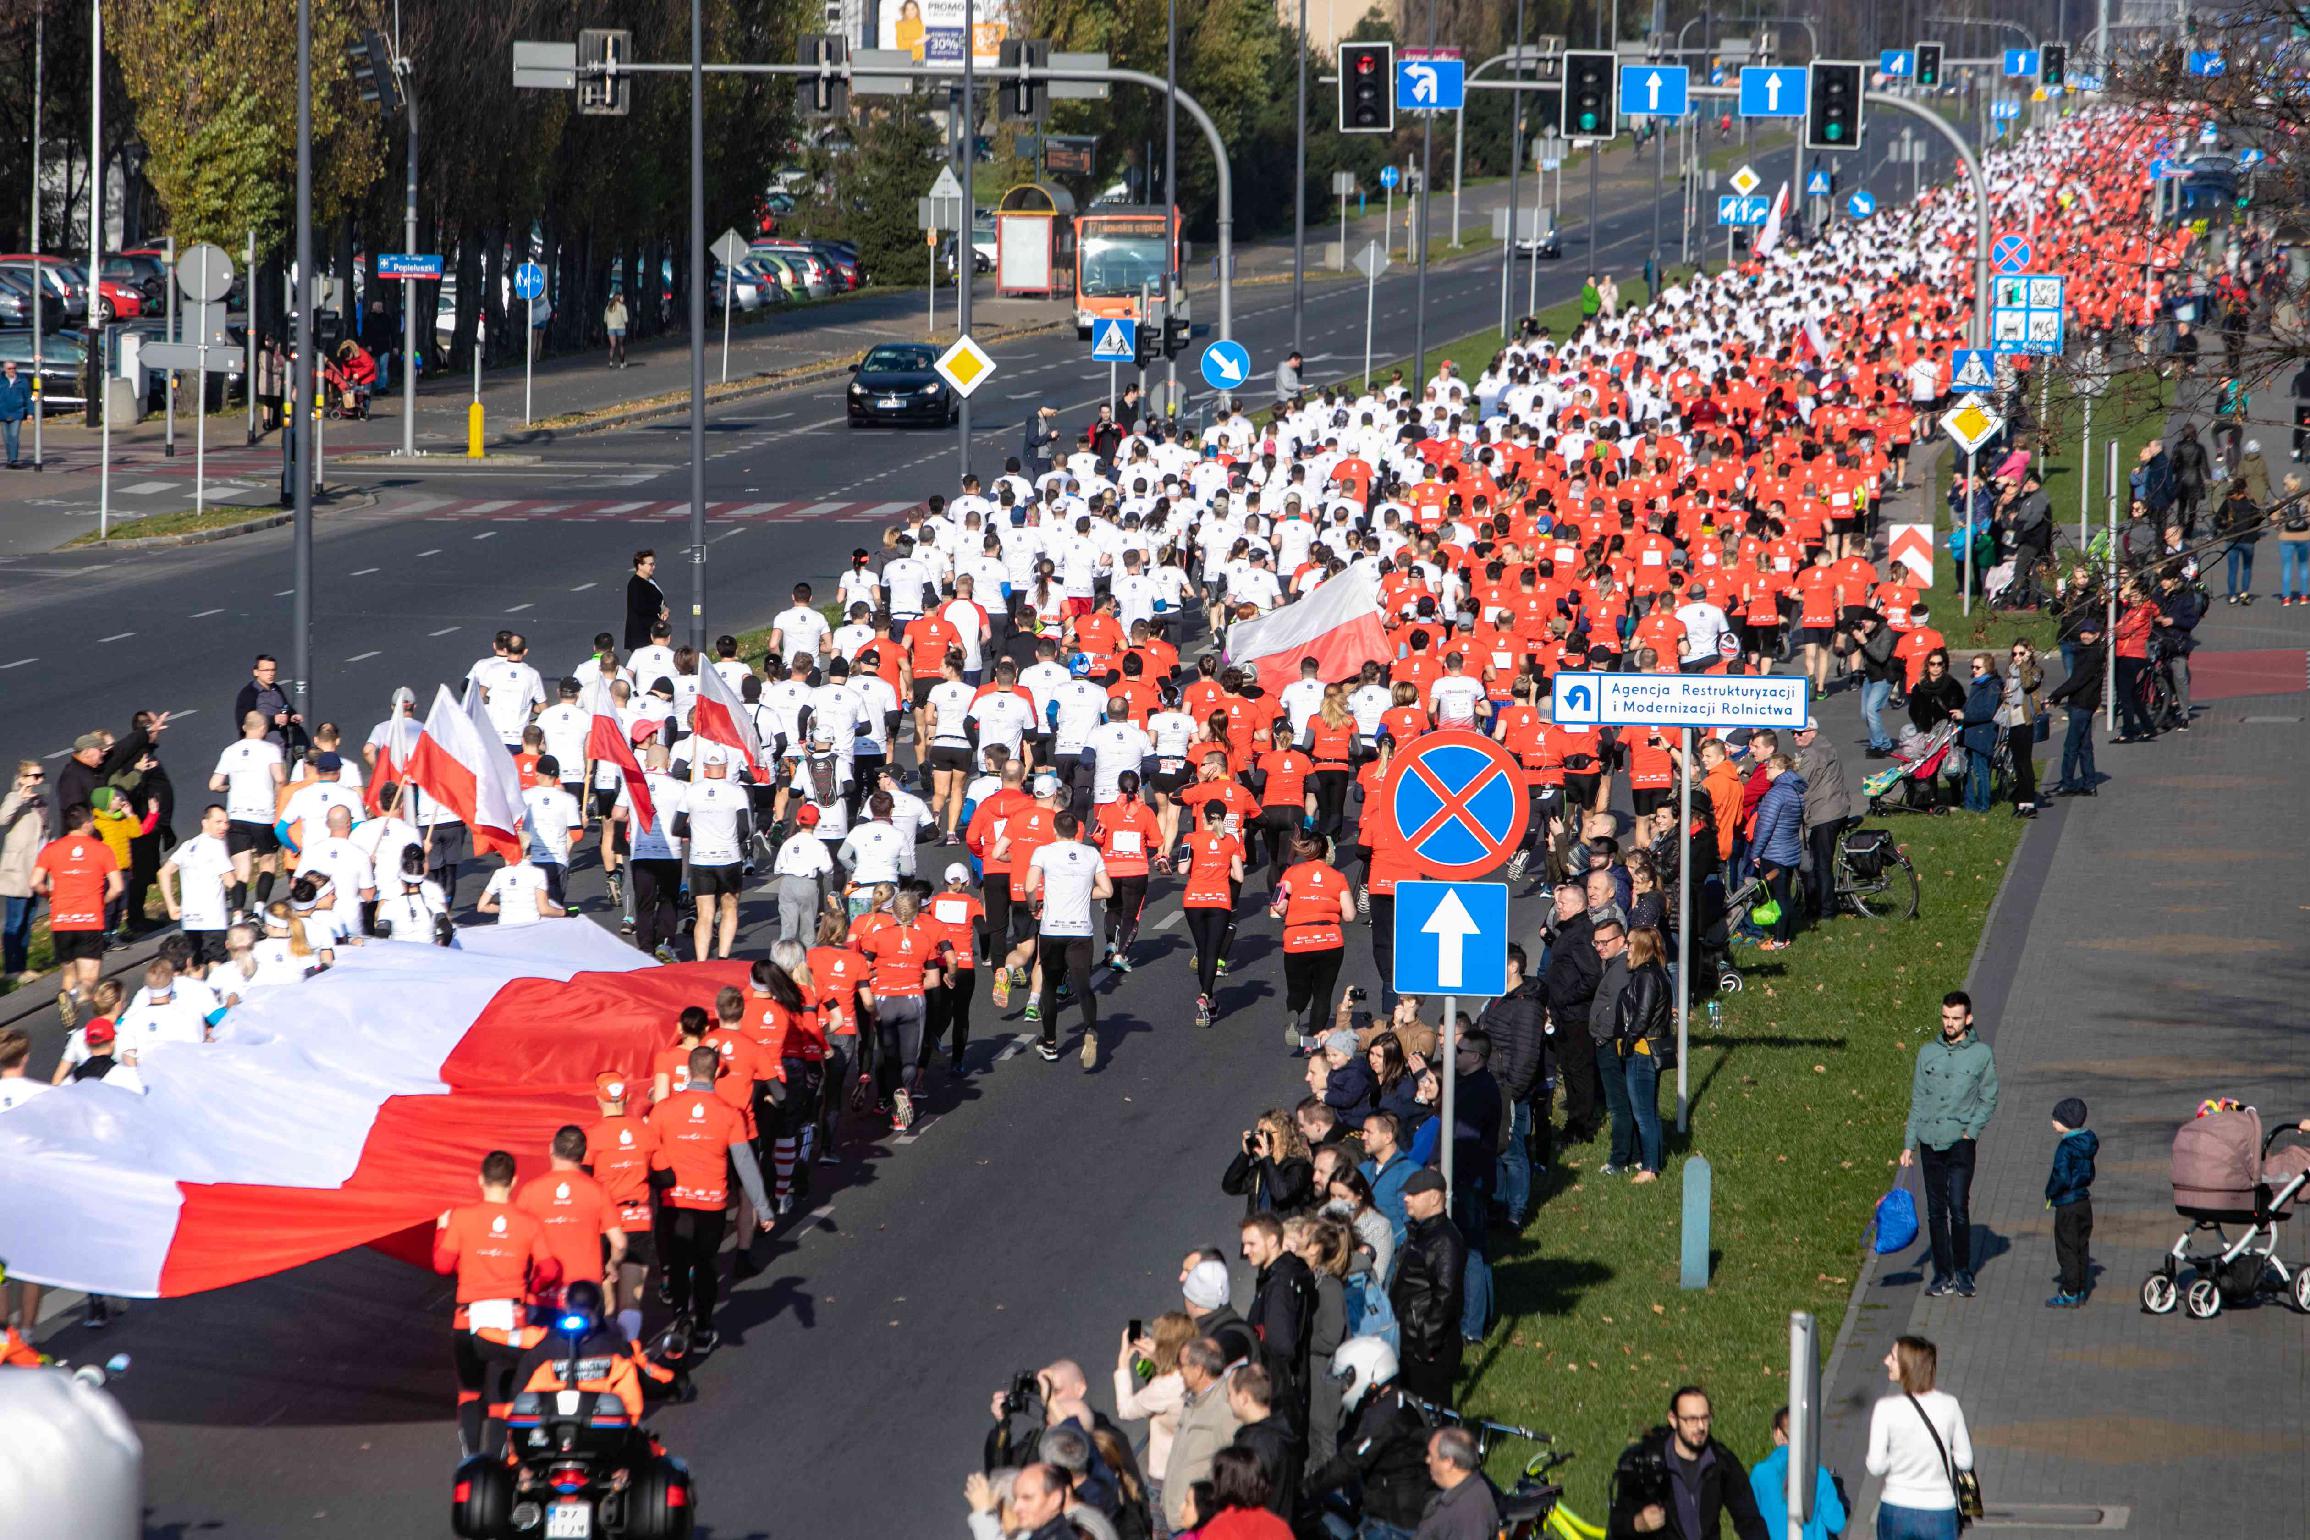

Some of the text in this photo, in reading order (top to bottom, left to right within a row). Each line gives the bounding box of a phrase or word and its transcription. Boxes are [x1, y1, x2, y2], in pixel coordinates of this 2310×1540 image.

[1612, 682, 1796, 700] Agencja Restrukturyzacji
[1613, 701, 1793, 716] i Modernizacji Rolnictwa
